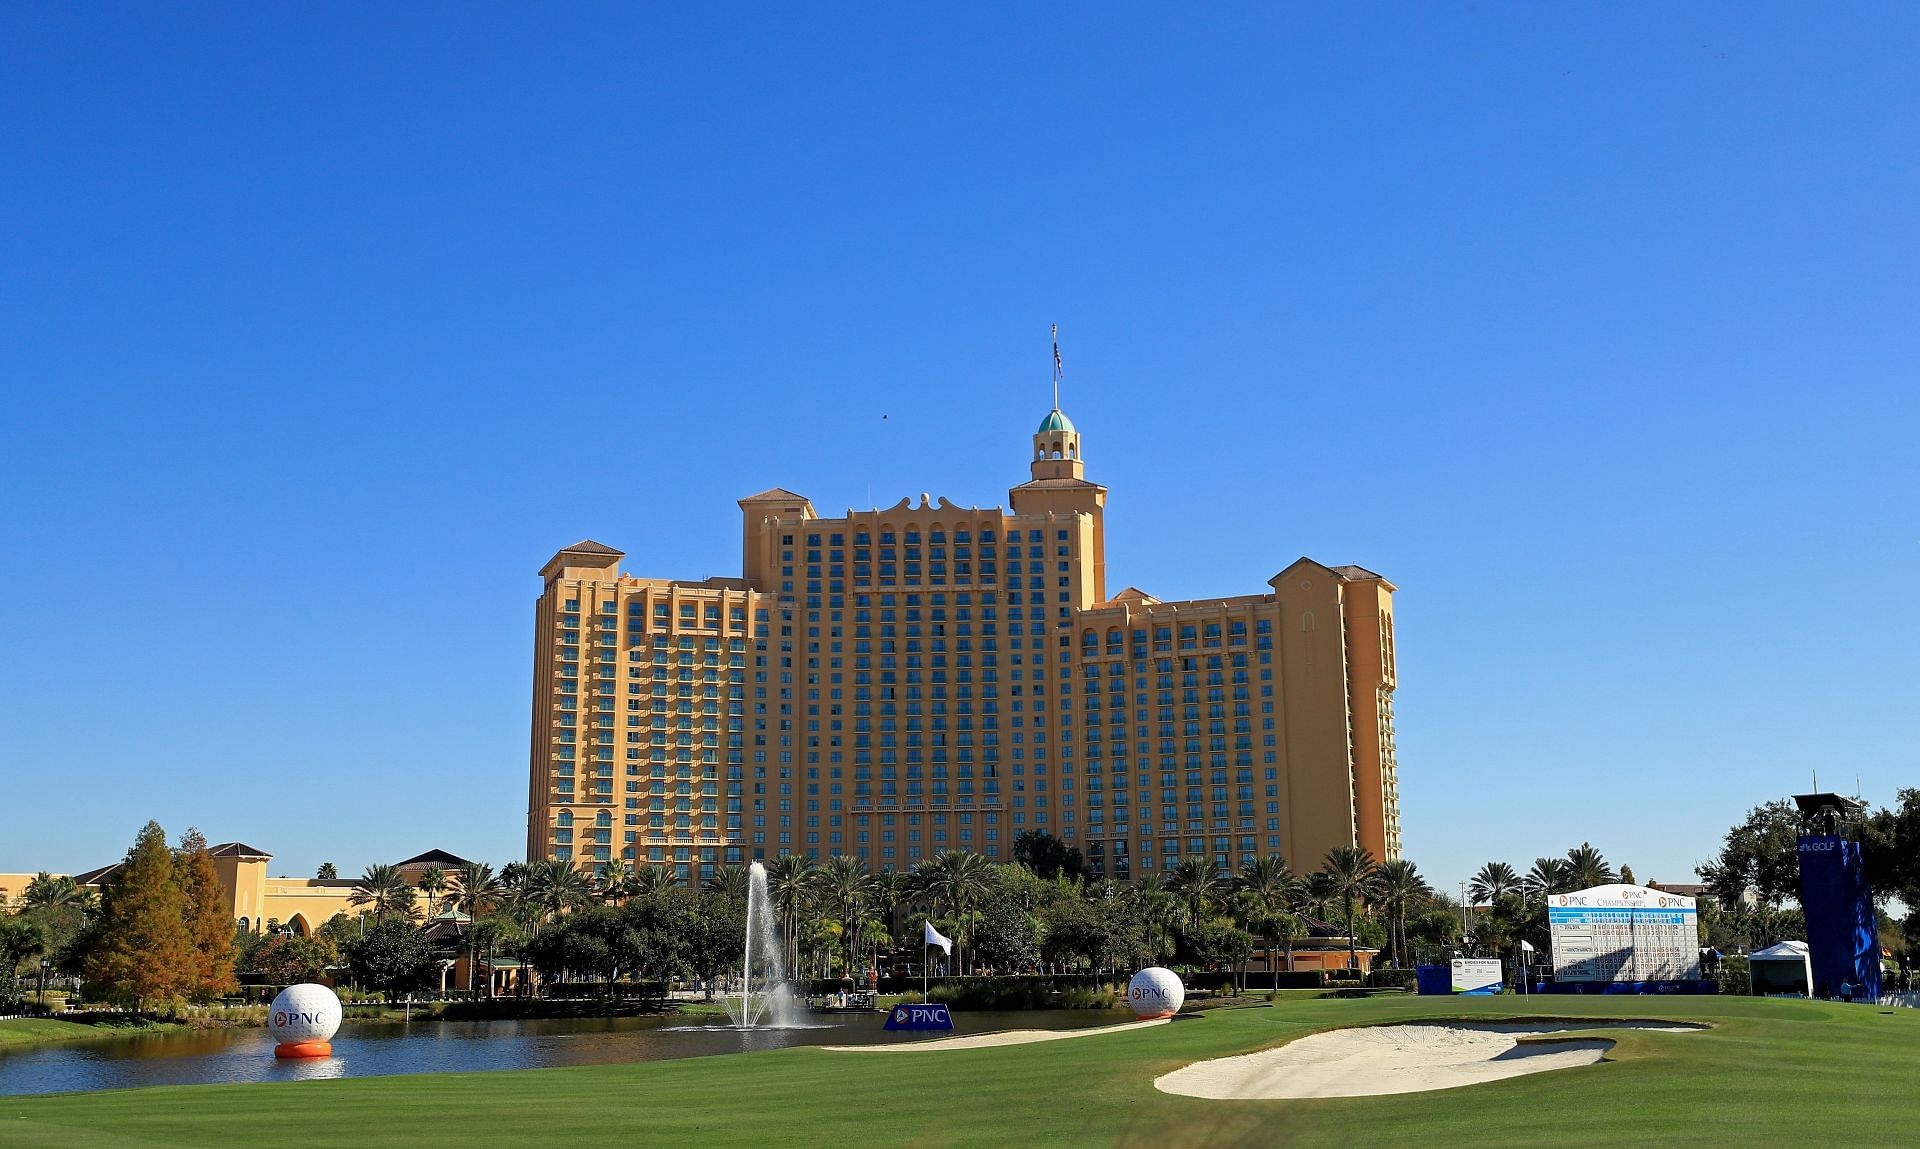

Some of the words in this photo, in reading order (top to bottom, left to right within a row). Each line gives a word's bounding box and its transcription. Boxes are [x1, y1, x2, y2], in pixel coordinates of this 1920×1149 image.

[1812, 842, 1835, 851] GOLF
[1629, 891, 1642, 899] PNC
[1569, 896, 1588, 906] PNC
[1669, 897, 1686, 907] PNC
[1142, 987, 1169, 999] PNC
[289, 1011, 325, 1026] PNC
[912, 1009, 946, 1023] PNC
